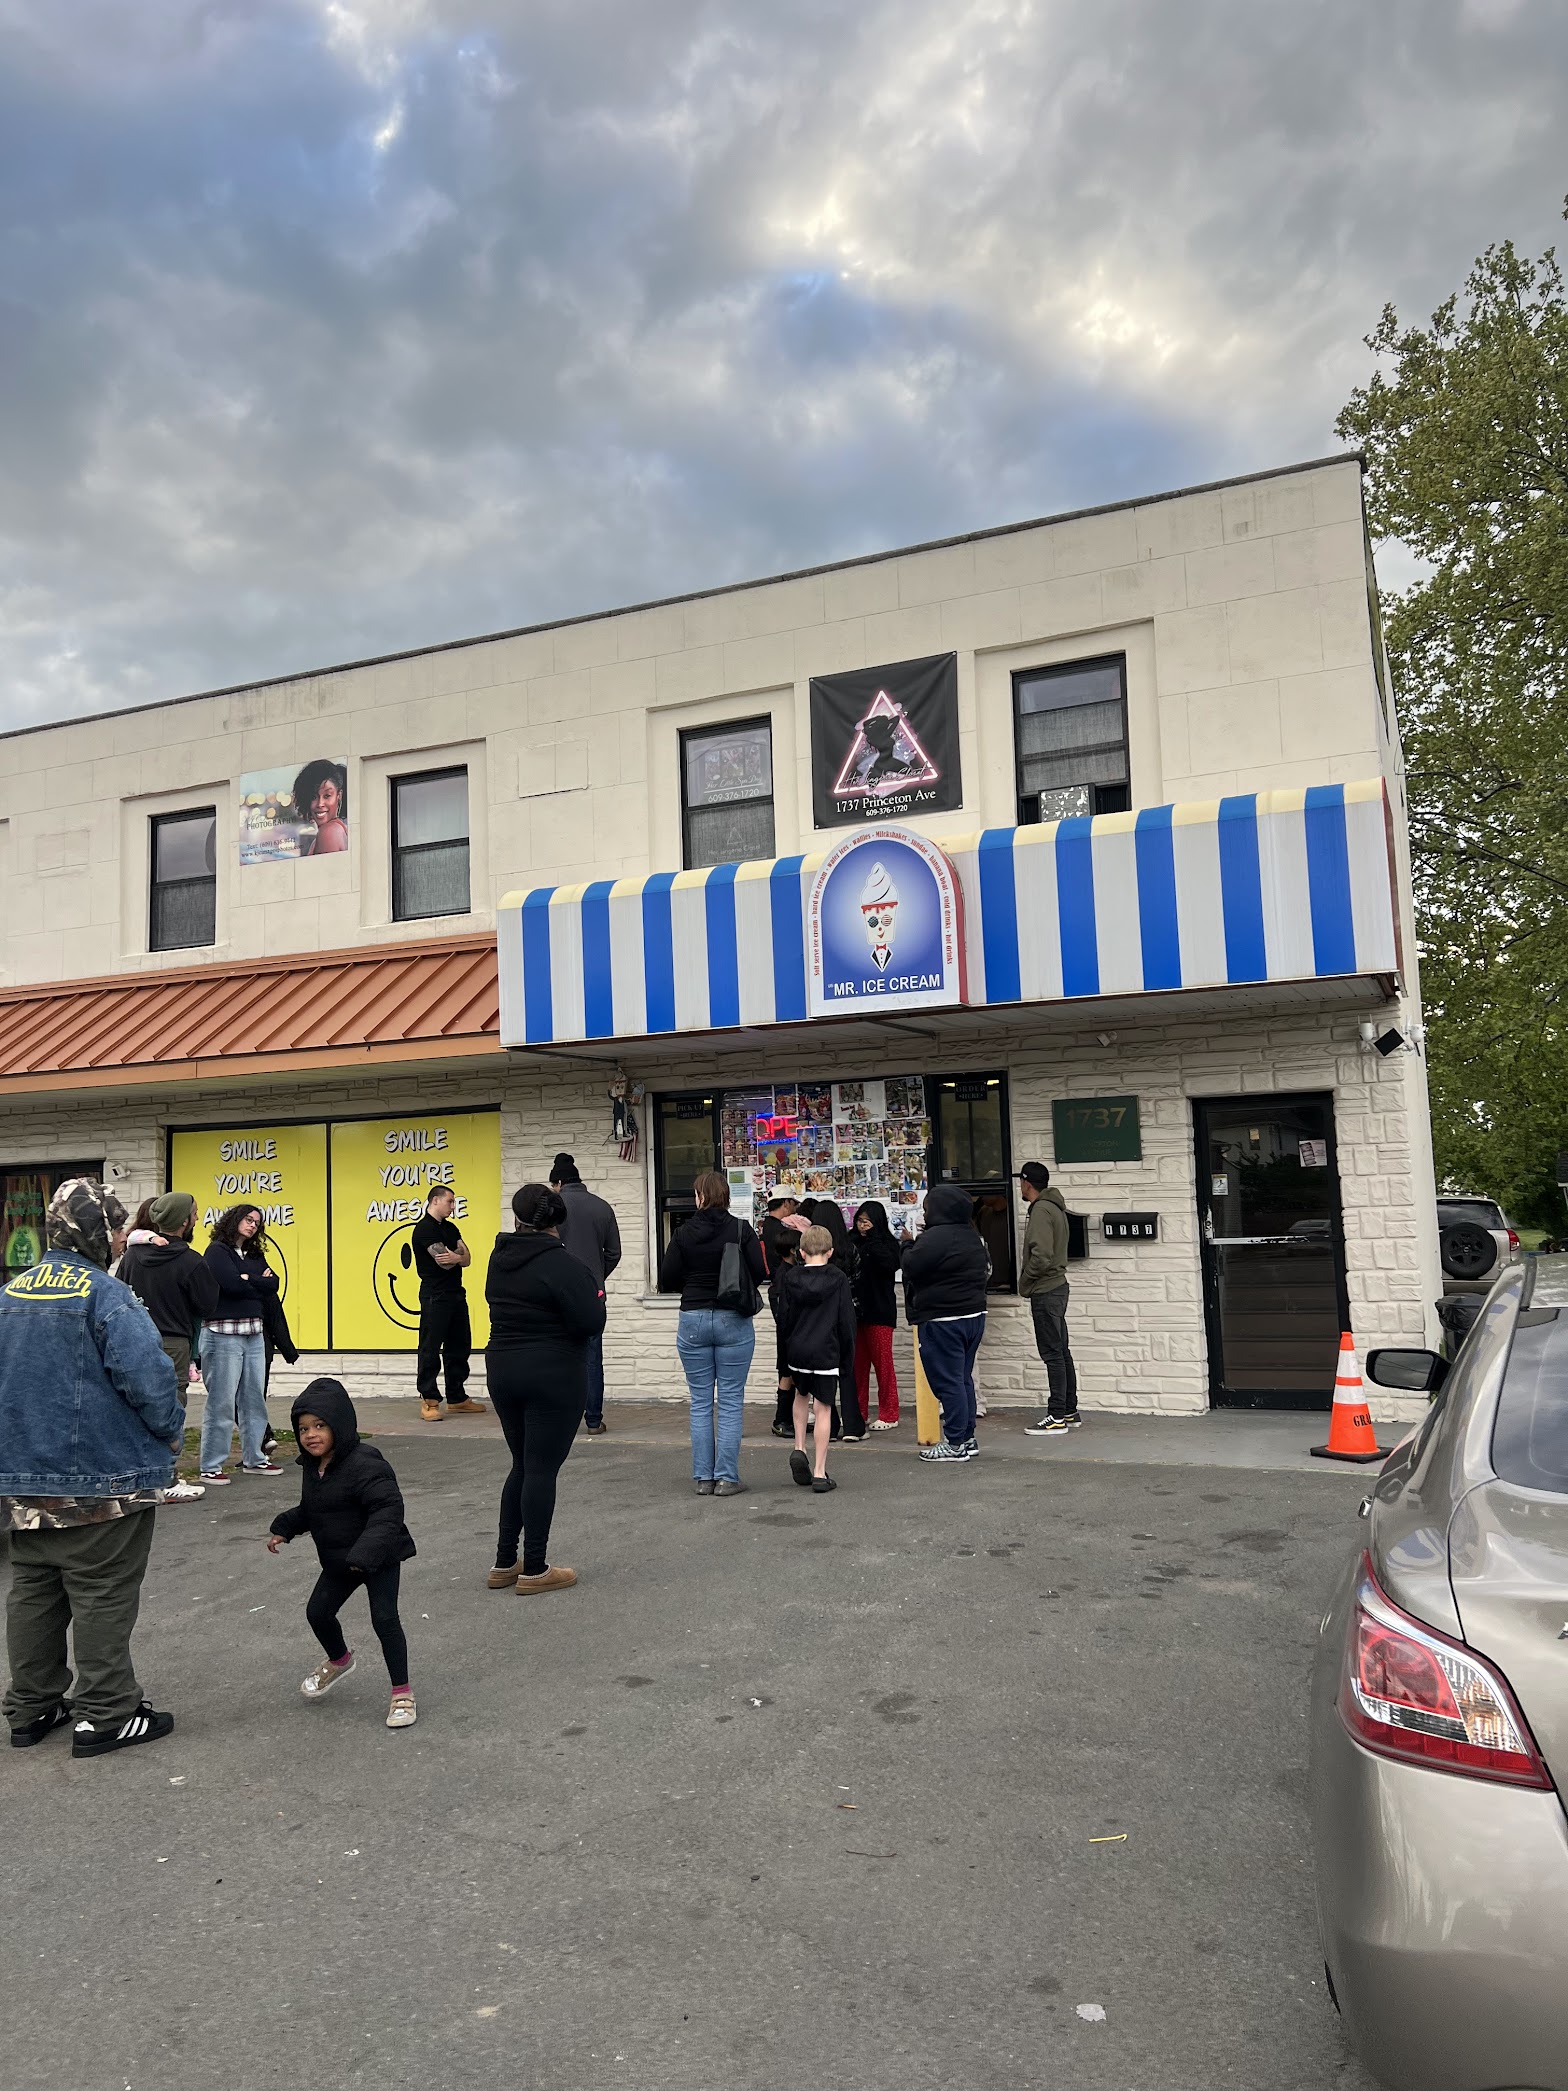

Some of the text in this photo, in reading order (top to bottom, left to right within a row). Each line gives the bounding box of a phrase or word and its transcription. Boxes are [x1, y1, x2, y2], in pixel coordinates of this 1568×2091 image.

[708, 788, 760, 803] 609-376-1720
[836, 789, 936, 813] 1737 Princeton Ave
[246, 815, 297, 830] PHOTOGRAPHY
[865, 804, 908, 817] 609-376-1720
[928, 854, 944, 877] banana
[834, 982, 858, 996] MR.
[862, 978, 886, 994] ICE
[889, 973, 940, 991] CREAM
[756, 1115, 798, 1140] OPE
[1066, 1107, 1127, 1128] 1737
[219, 1138, 278, 1162] SMILE
[383, 1127, 449, 1153] SMILE
[214, 1170, 283, 1195] YOU'RE
[378, 1161, 456, 1188] YOU'RE
[203, 1204, 295, 1229] AWME
[366, 1196, 469, 1223] AWESE
[33, 1263, 93, 1298] Dutch
